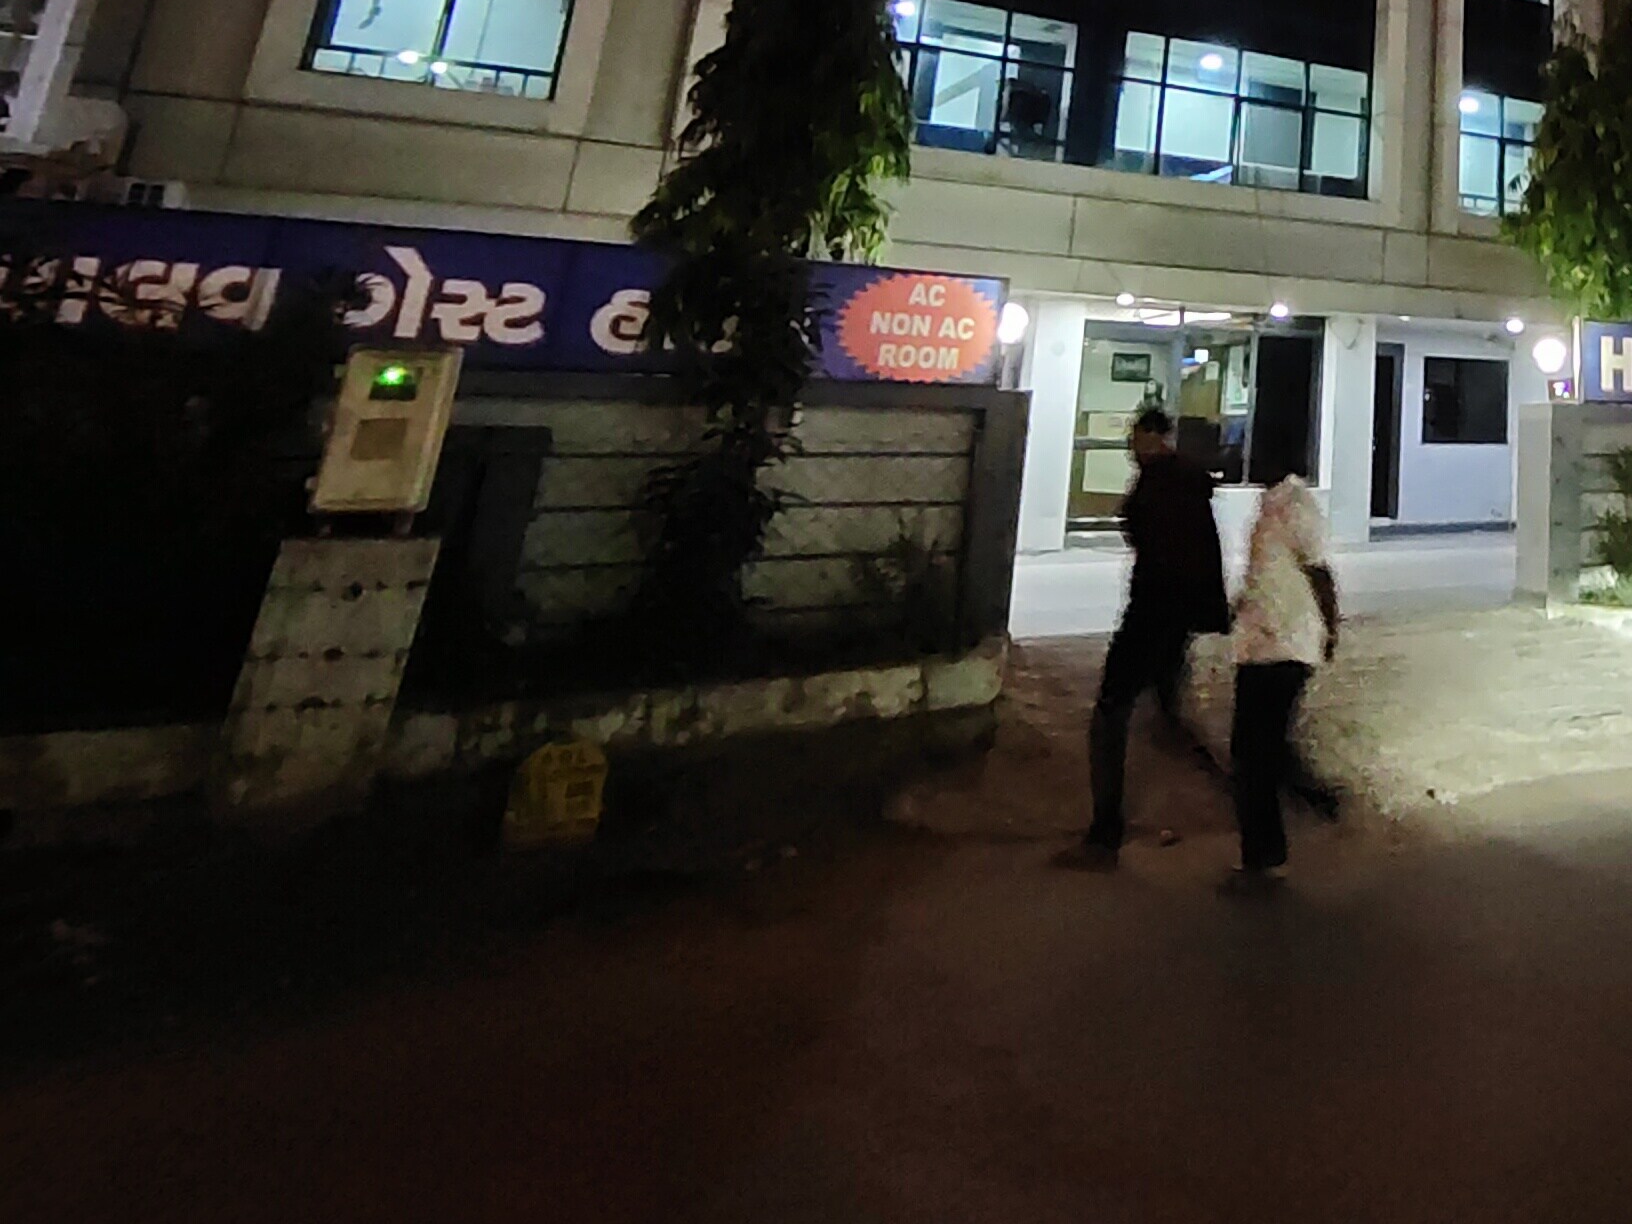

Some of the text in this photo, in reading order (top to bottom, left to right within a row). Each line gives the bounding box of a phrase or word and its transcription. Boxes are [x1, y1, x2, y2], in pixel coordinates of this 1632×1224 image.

[908, 282, 946, 308] AC
[869, 311, 975, 341] NON AC
[878, 343, 960, 370] ROOM
